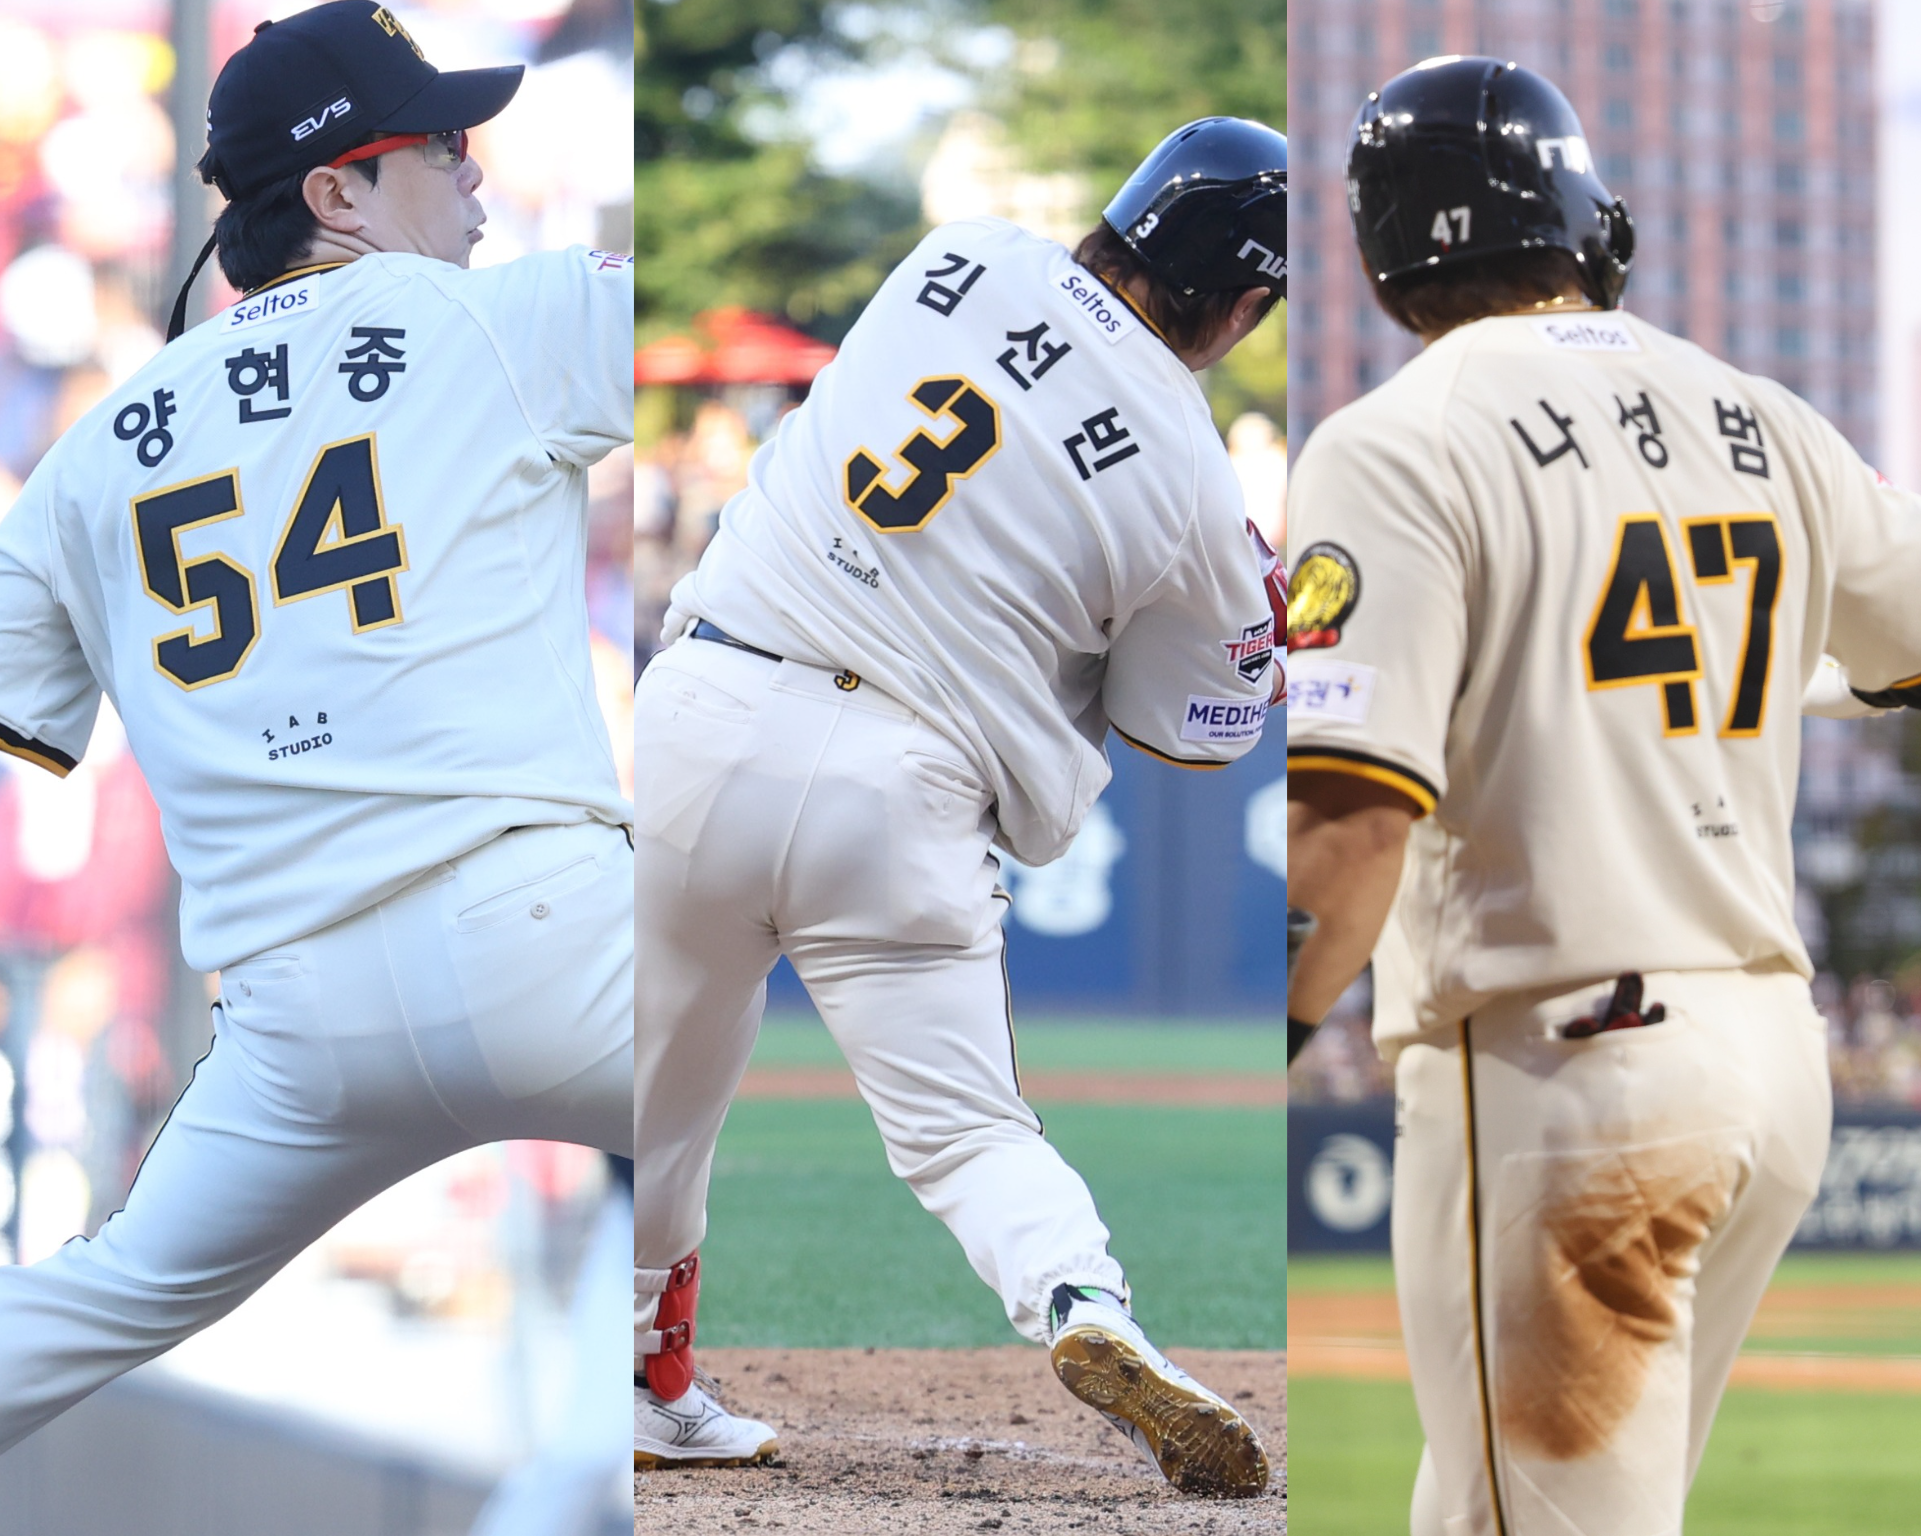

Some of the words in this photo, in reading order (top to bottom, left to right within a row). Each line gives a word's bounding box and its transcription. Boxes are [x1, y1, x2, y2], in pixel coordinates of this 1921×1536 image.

[1136, 213, 1159, 239] 3
[1431, 206, 1471, 245] 47
[230, 288, 308, 327] Seltos
[1061, 274, 1121, 334] Seltos
[1545, 324, 1628, 345] Seltos
[844, 374, 1002, 534] 3
[129, 431, 409, 692] 54
[827, 551, 879, 589] STUDIO
[1582, 513, 1784, 738] 47
[1187, 700, 1270, 726] MEDIHE
[268, 733, 332, 761] STUDIO
